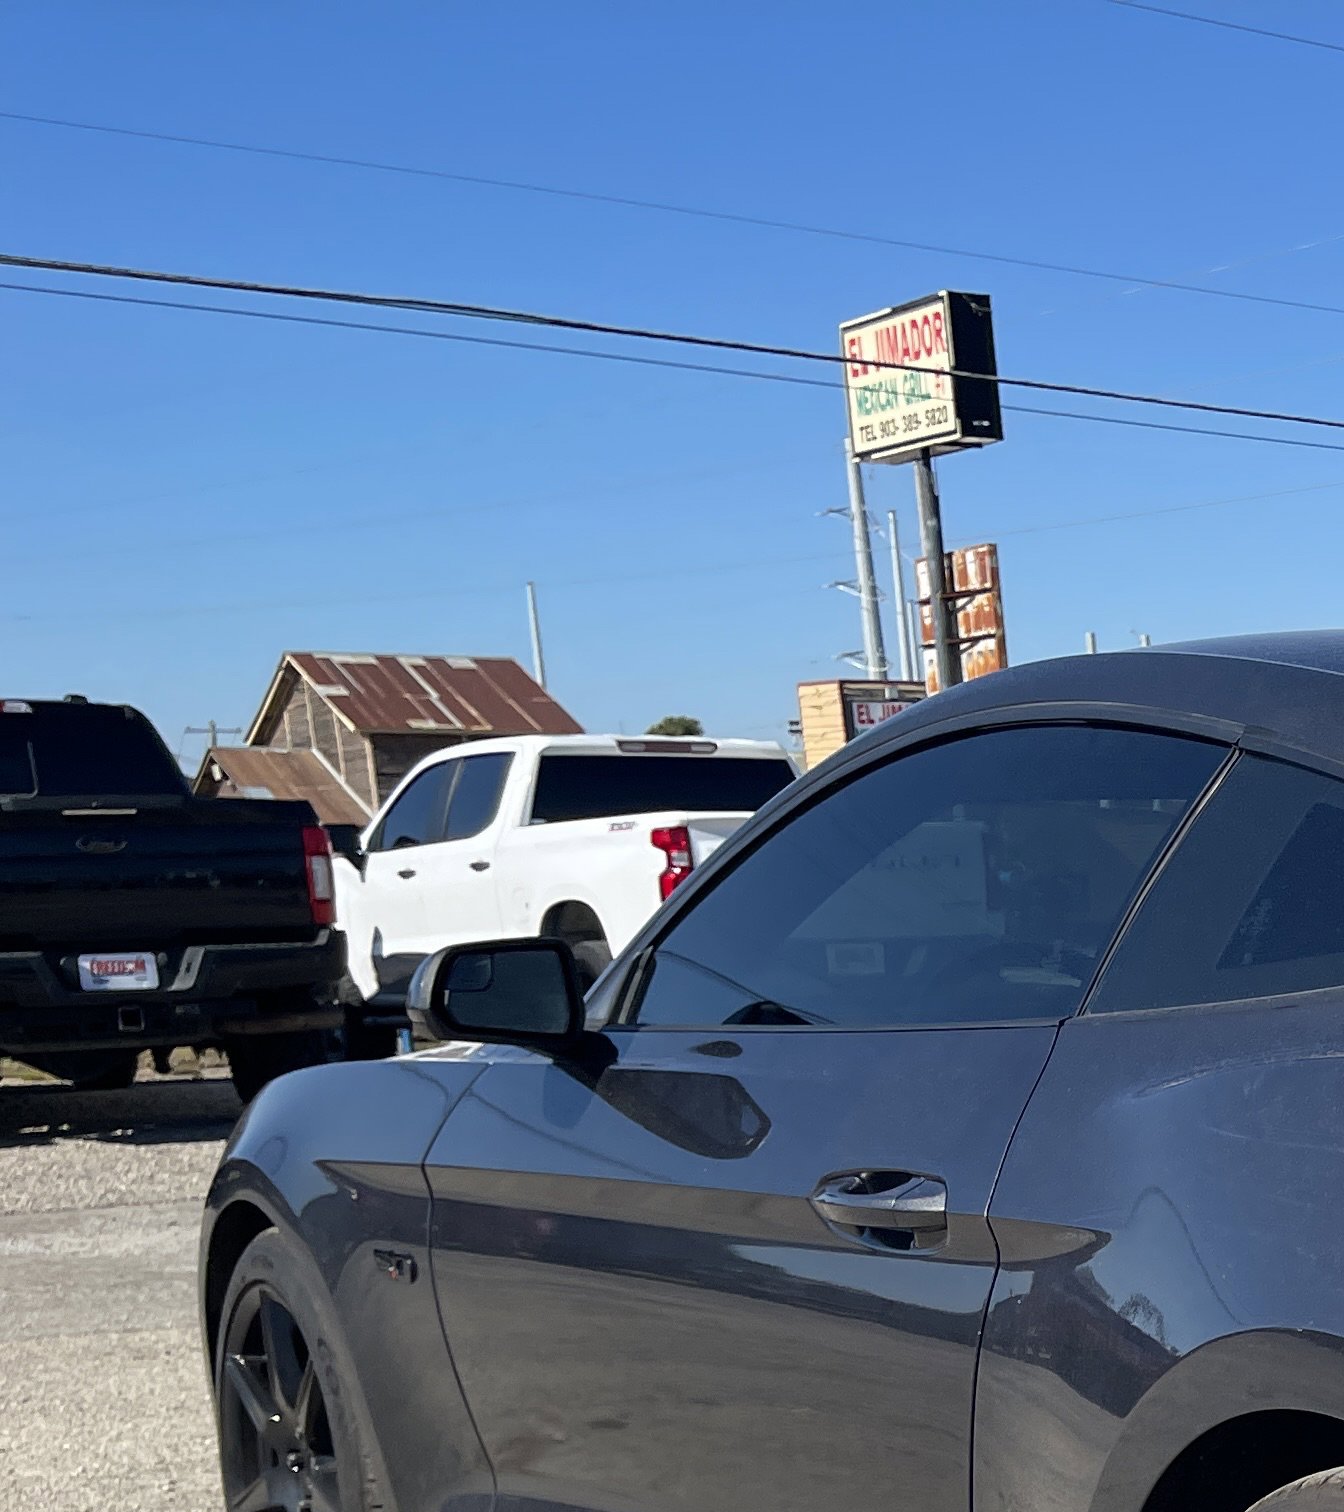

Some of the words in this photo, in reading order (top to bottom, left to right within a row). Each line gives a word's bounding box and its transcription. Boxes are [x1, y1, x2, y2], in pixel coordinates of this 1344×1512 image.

[848, 336, 868, 378] EL
[873, 311, 947, 373] JIMADOR
[857, 704, 875, 724] EL
